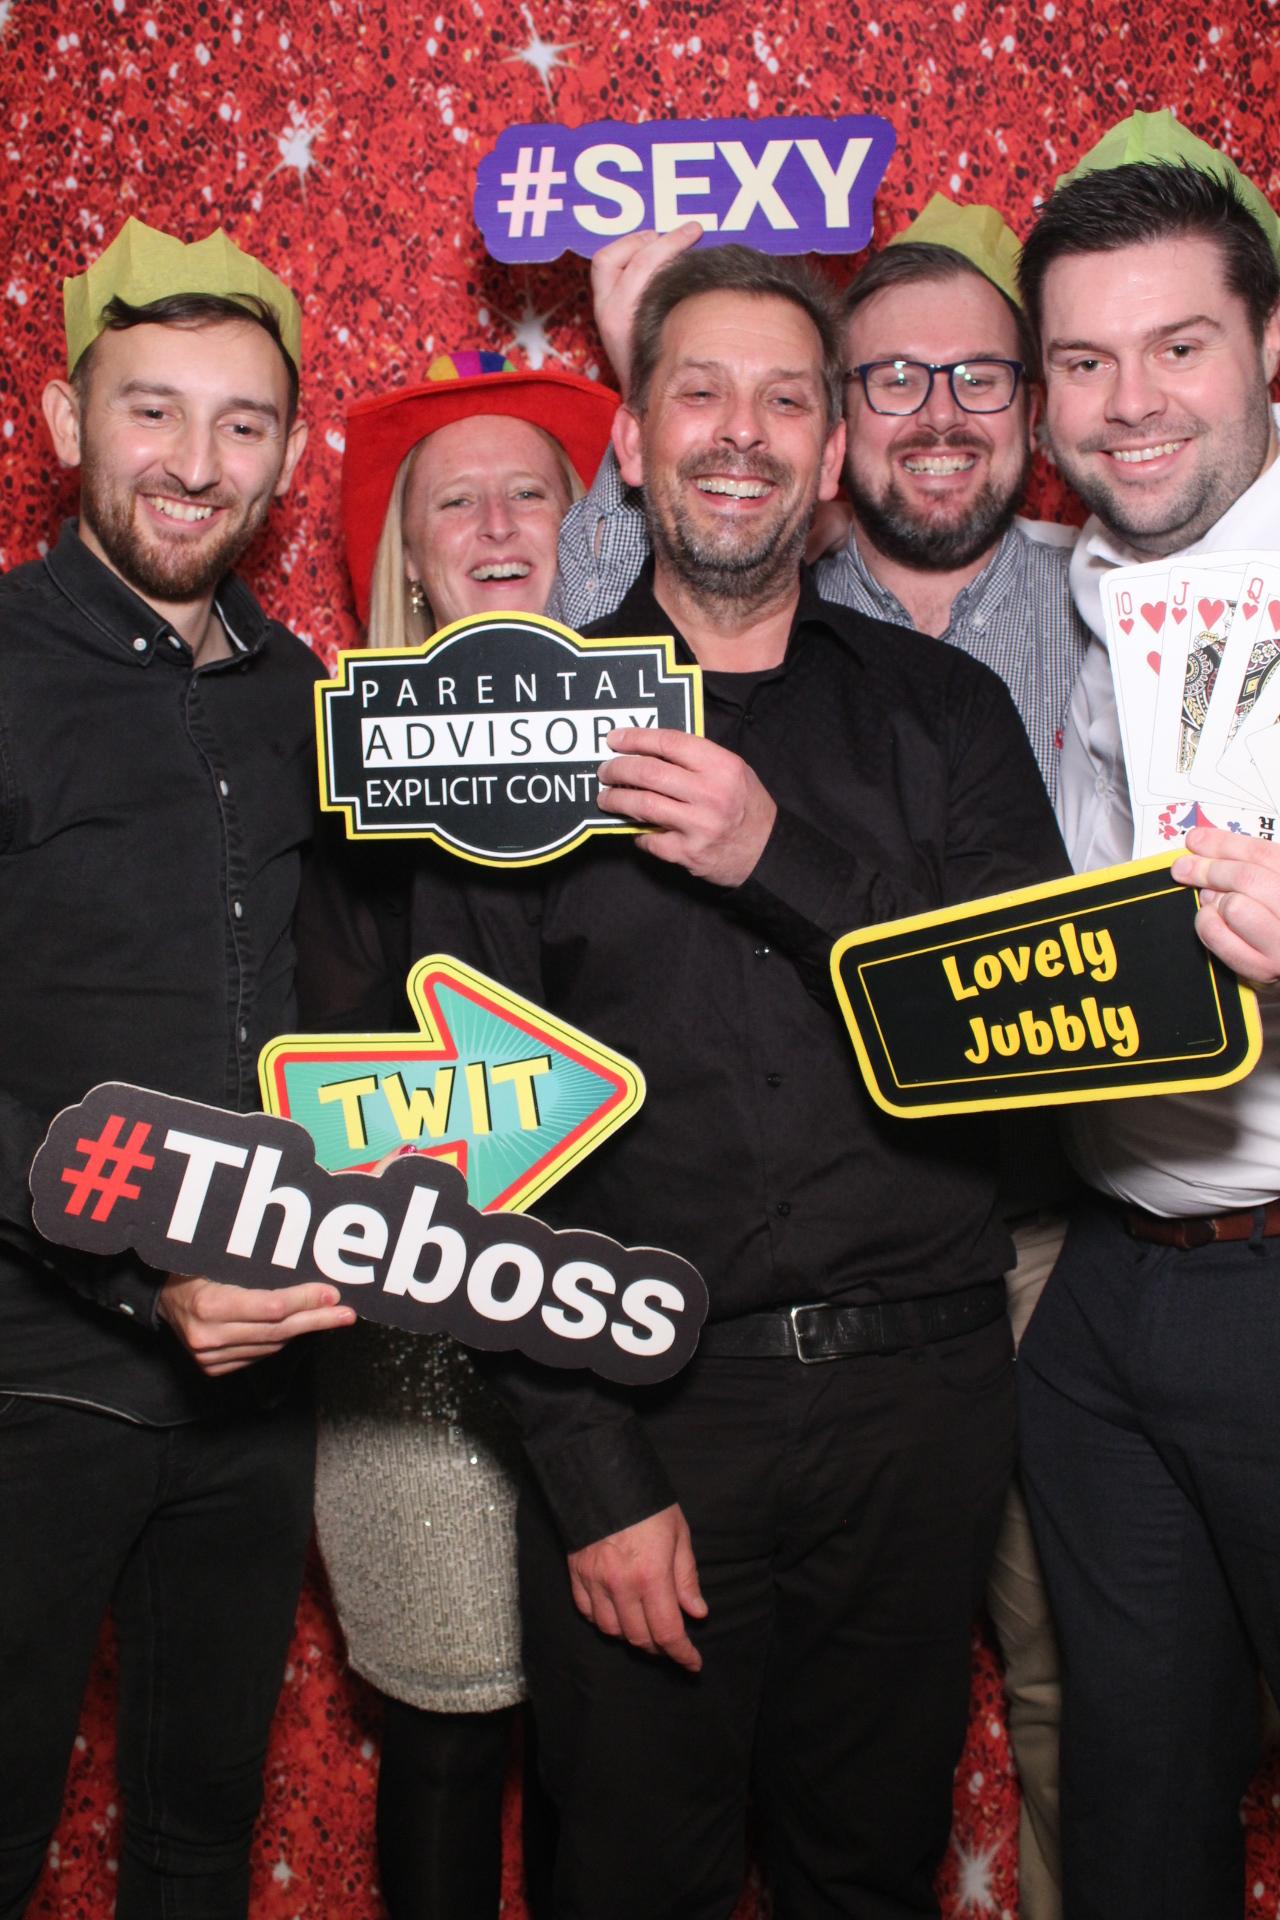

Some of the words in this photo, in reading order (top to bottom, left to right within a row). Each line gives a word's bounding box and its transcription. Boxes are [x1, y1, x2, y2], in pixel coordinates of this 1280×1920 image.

[497, 137, 873, 238] #SEXY
[1115, 591, 1133, 617] 10
[1173, 581, 1190, 606] J
[1247, 577, 1264, 604] Q
[362, 669, 656, 708] PARENTAL
[366, 776, 498, 808] EXPLICIT
[506, 773, 611, 805] CONT
[941, 922, 1118, 1001] Lovely
[963, 996, 1140, 1065] Jubbly
[318, 1055, 553, 1150] TWIT
[61, 1114, 686, 1357] #Theboss
